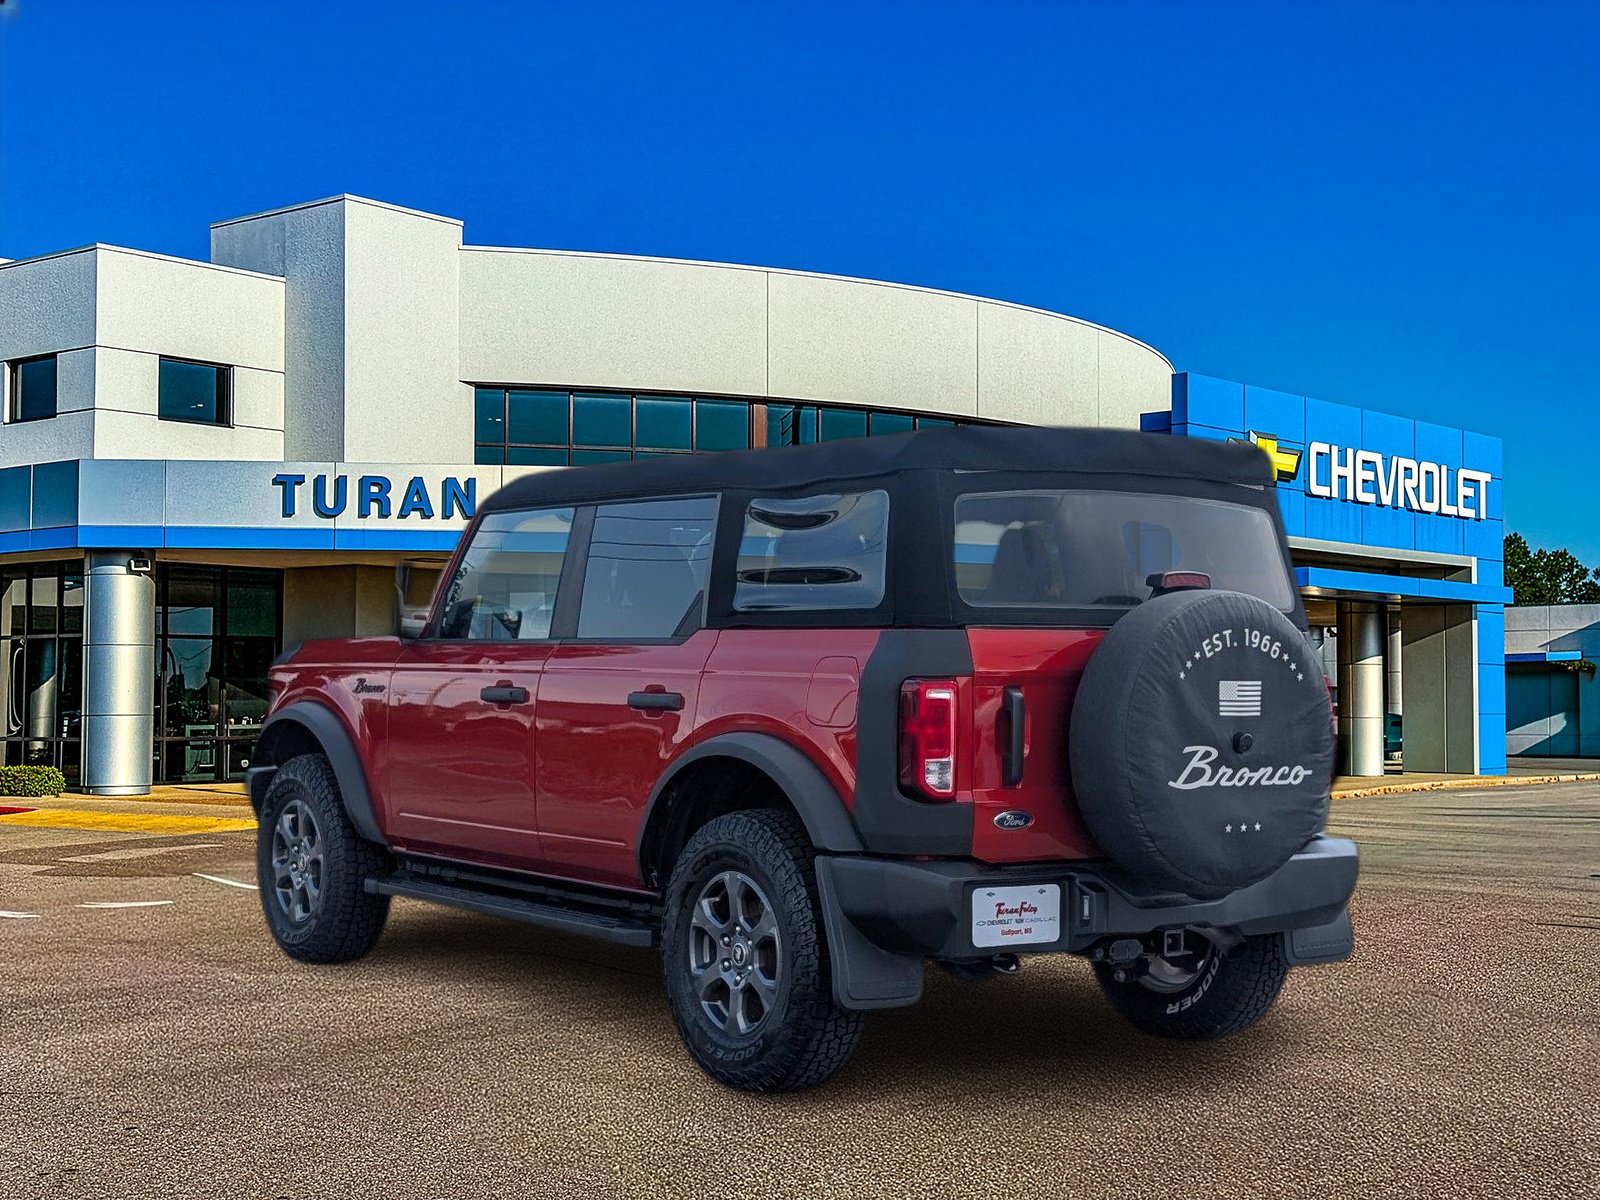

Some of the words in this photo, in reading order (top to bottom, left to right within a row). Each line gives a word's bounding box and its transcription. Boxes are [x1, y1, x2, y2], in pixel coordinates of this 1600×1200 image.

[271, 473, 477, 519] TURAN
[1308, 440, 1492, 520] CHEVROLET
[1202, 629, 1238, 659] EST.
[1244, 628, 1282, 659] 1966
[1167, 745, 1313, 790] Bronco
[1025, 916, 1057, 924] CADILLAC
